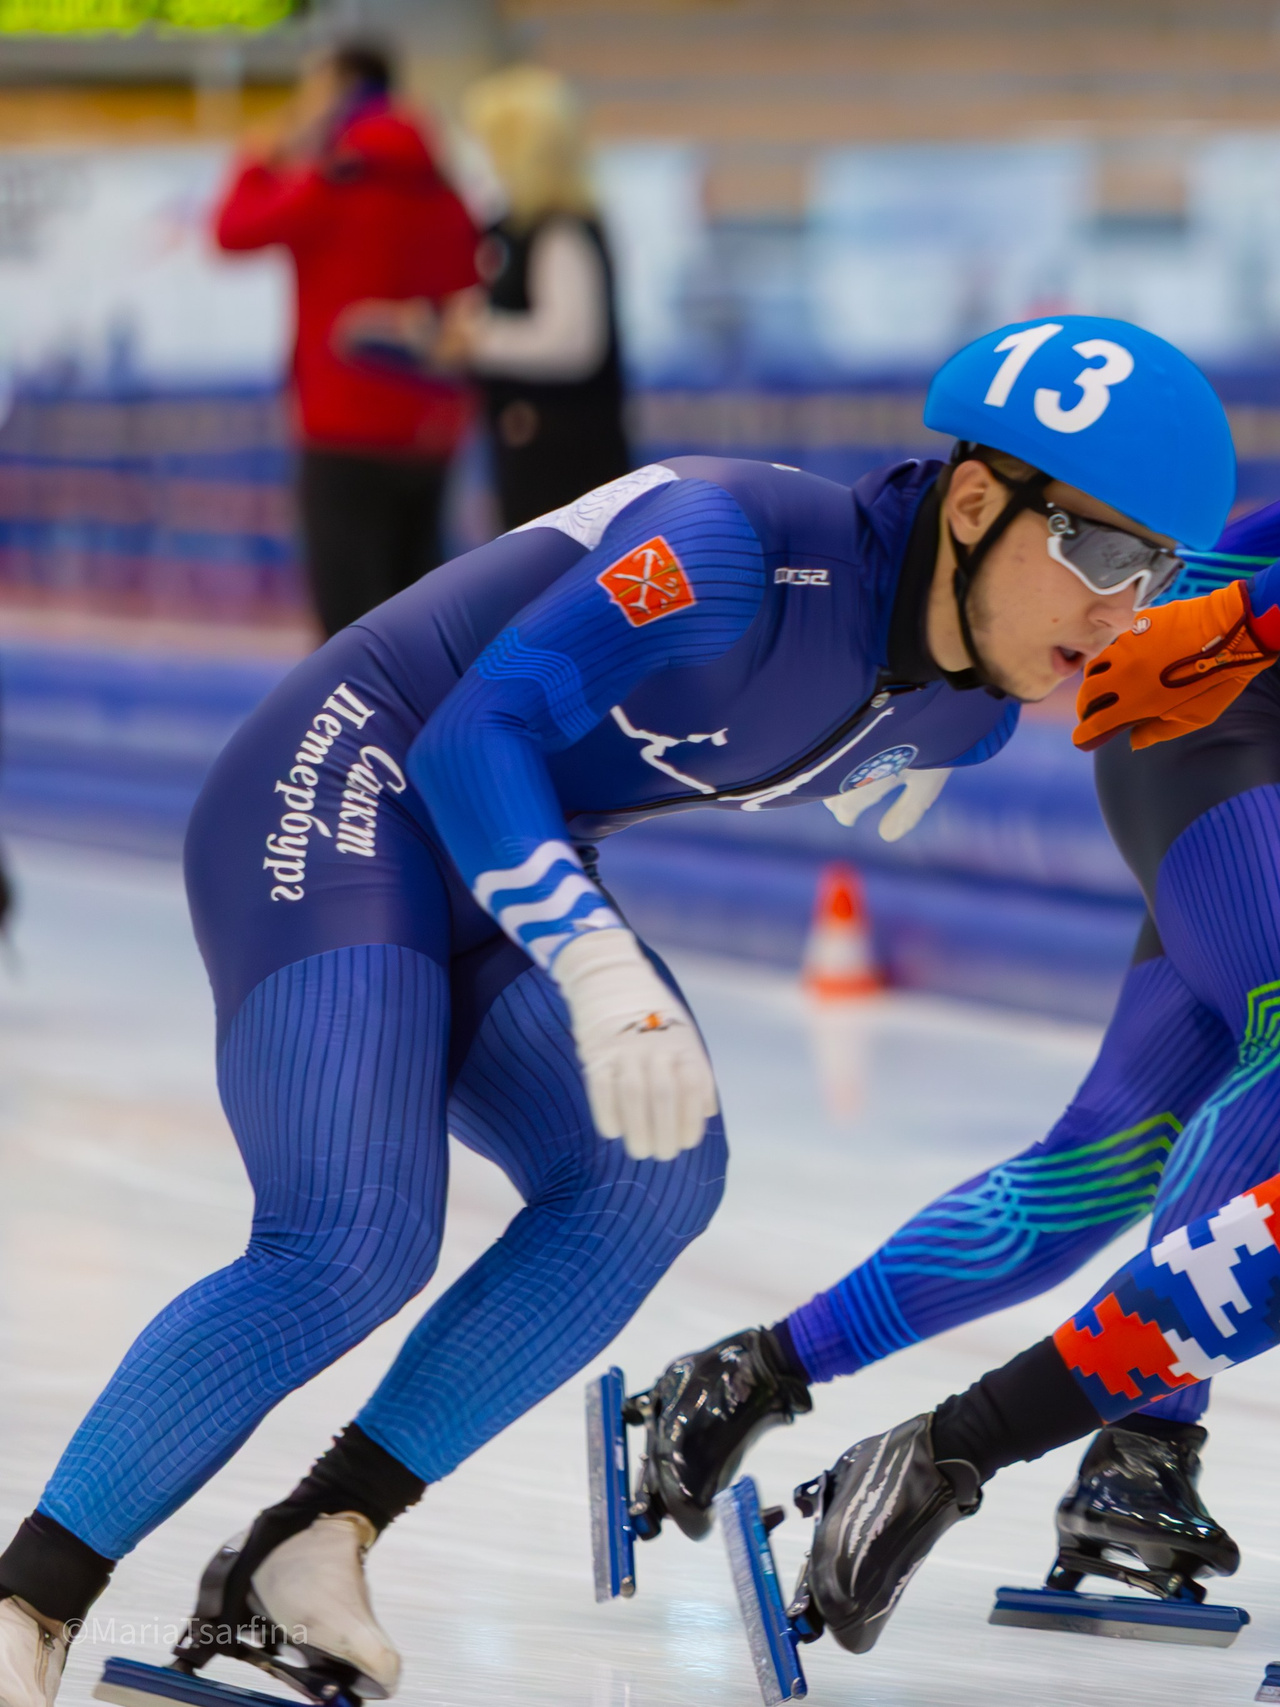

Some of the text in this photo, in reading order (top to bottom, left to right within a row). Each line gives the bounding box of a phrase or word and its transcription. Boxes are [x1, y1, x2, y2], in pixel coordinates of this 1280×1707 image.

[983, 323, 1134, 433] 13
[263, 683, 375, 901] Петербург
[336, 745, 407, 858] Санкт
